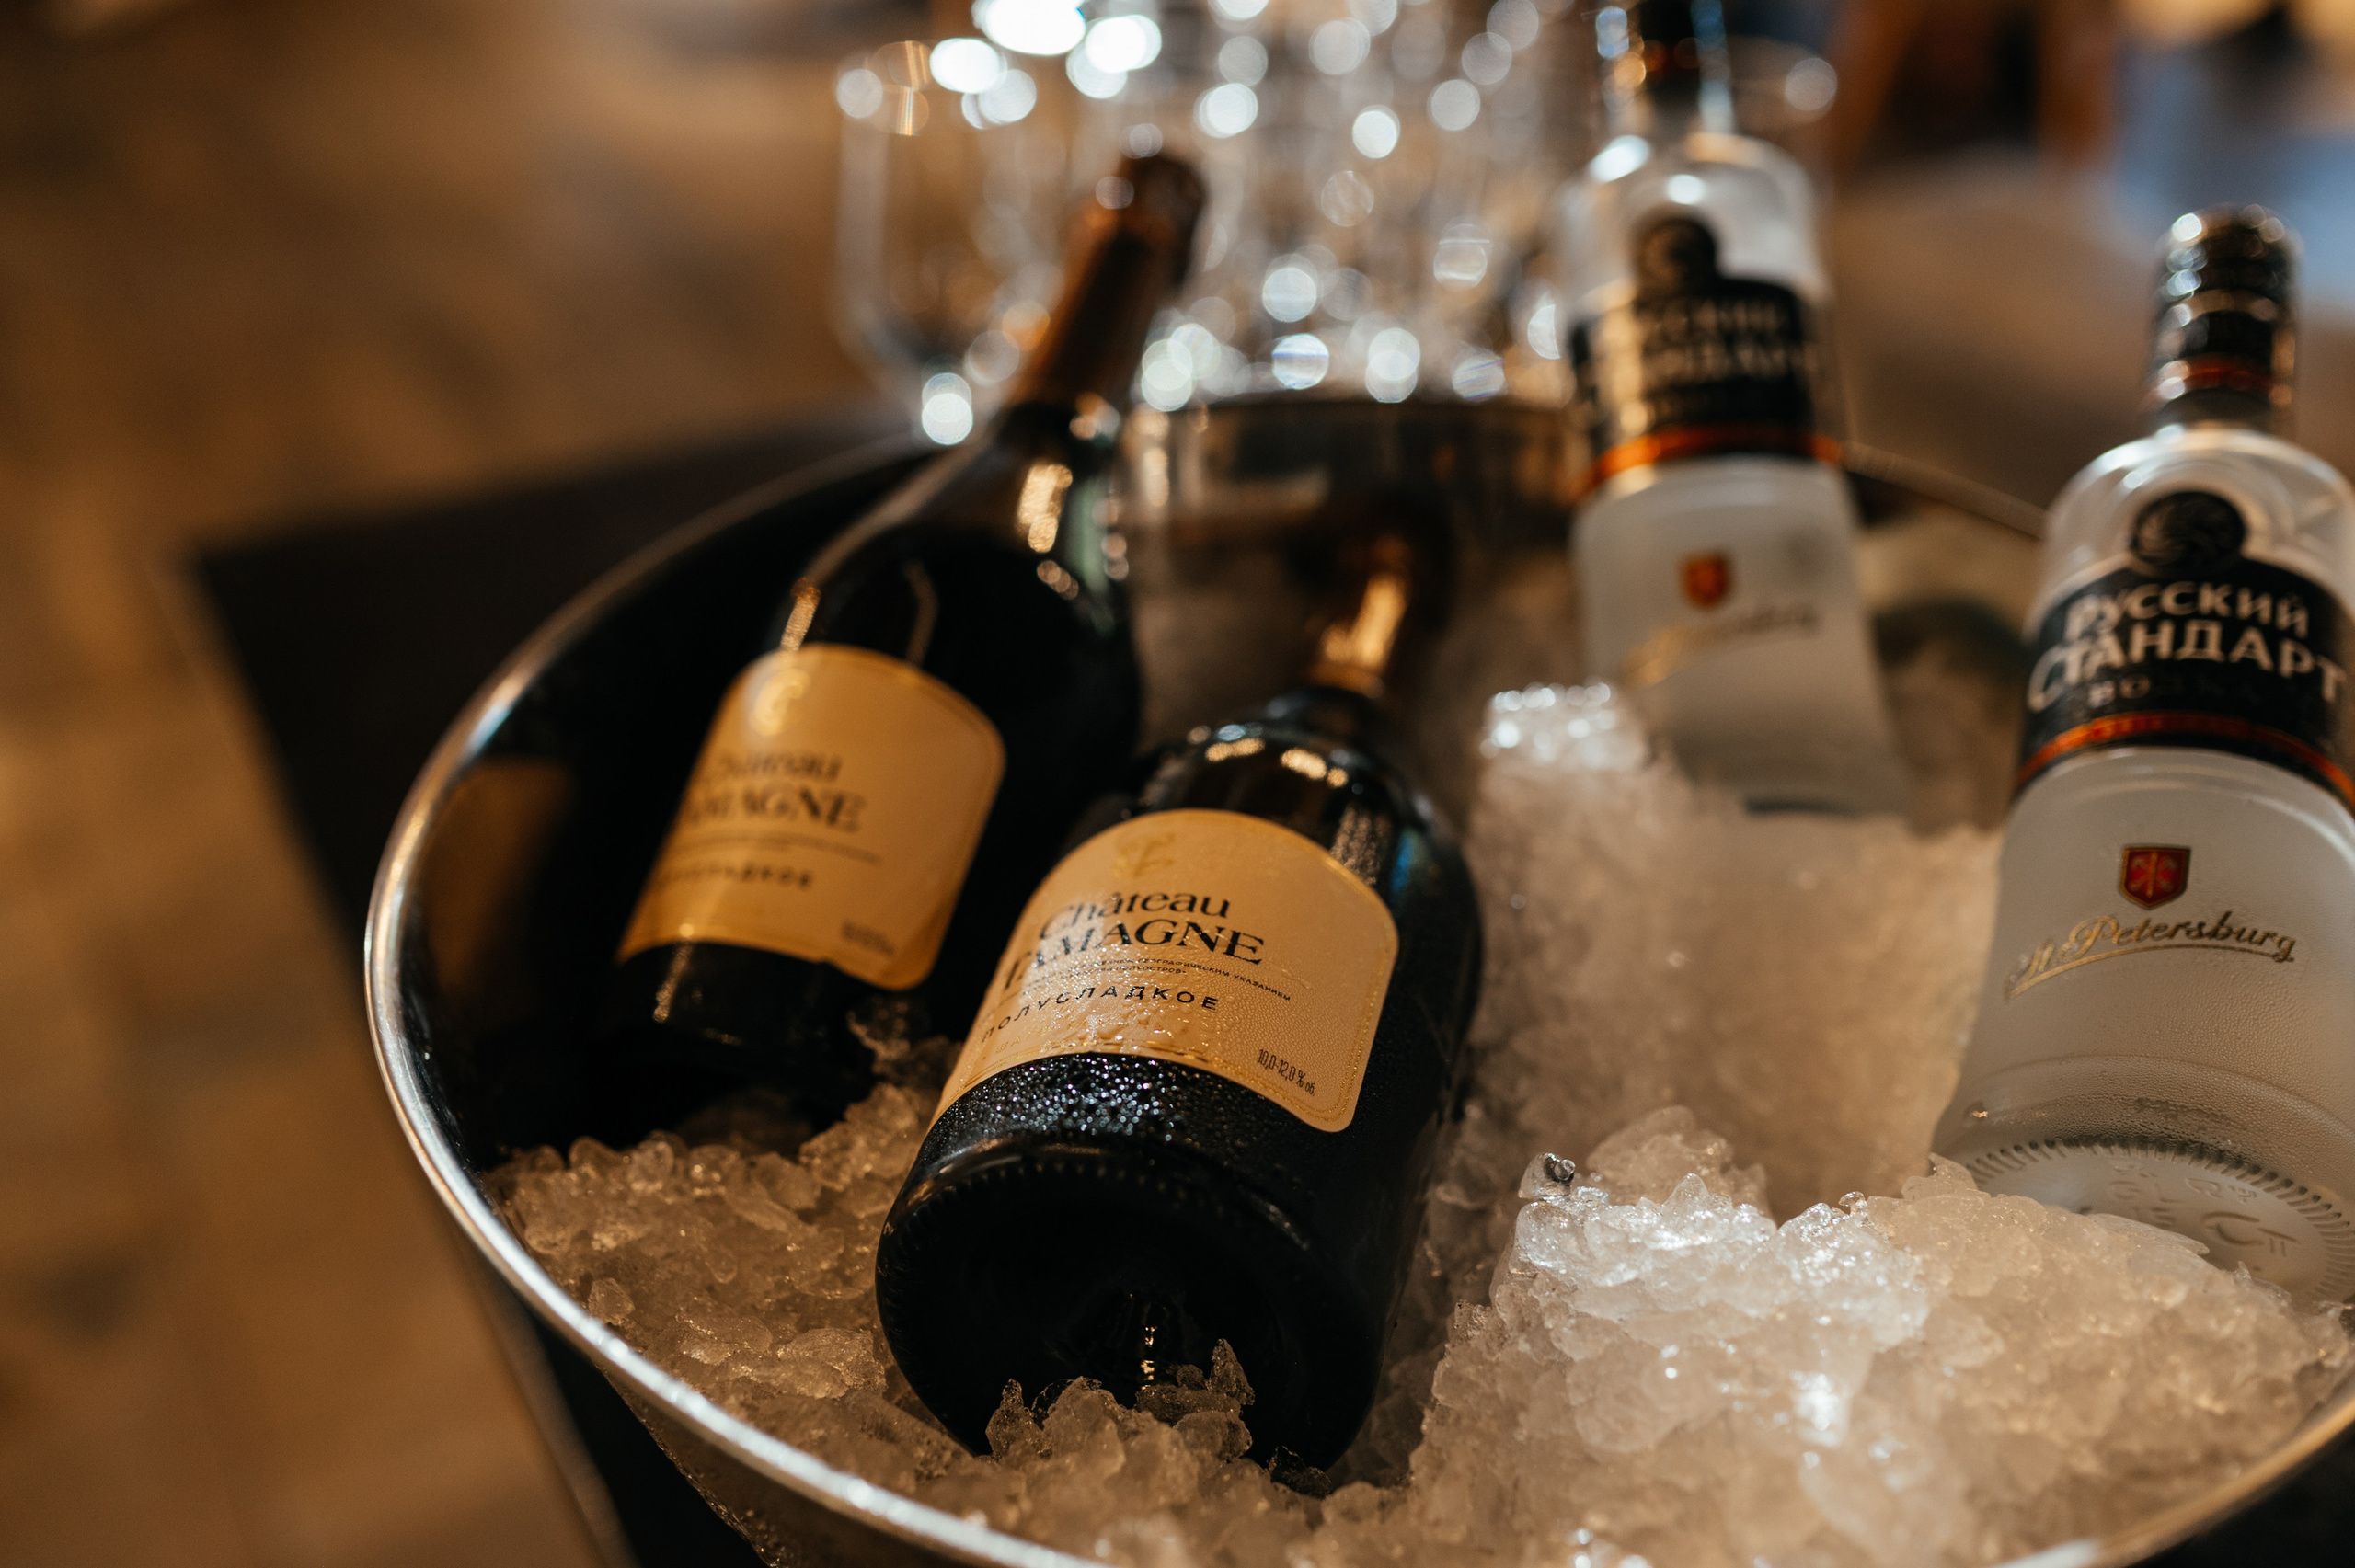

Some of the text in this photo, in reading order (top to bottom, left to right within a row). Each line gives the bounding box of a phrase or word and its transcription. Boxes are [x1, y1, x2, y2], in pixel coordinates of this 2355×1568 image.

[2066, 579, 2310, 640] РУССКИЙ
[2028, 618, 2347, 713] СТАНДАРТ
[1040, 890, 1231, 940] Château
[2059, 911, 2294, 964] Petersburg
[1137, 957, 1230, 979] ГЕОГРАФИЧЕСКИМ
[1233, 972, 1291, 1001] УКАЗАНИЕМ
[982, 985, 1219, 1043] ПОЛУСЛАДКОЕ
[1258, 1048, 1296, 1082] 10,0-12,0
